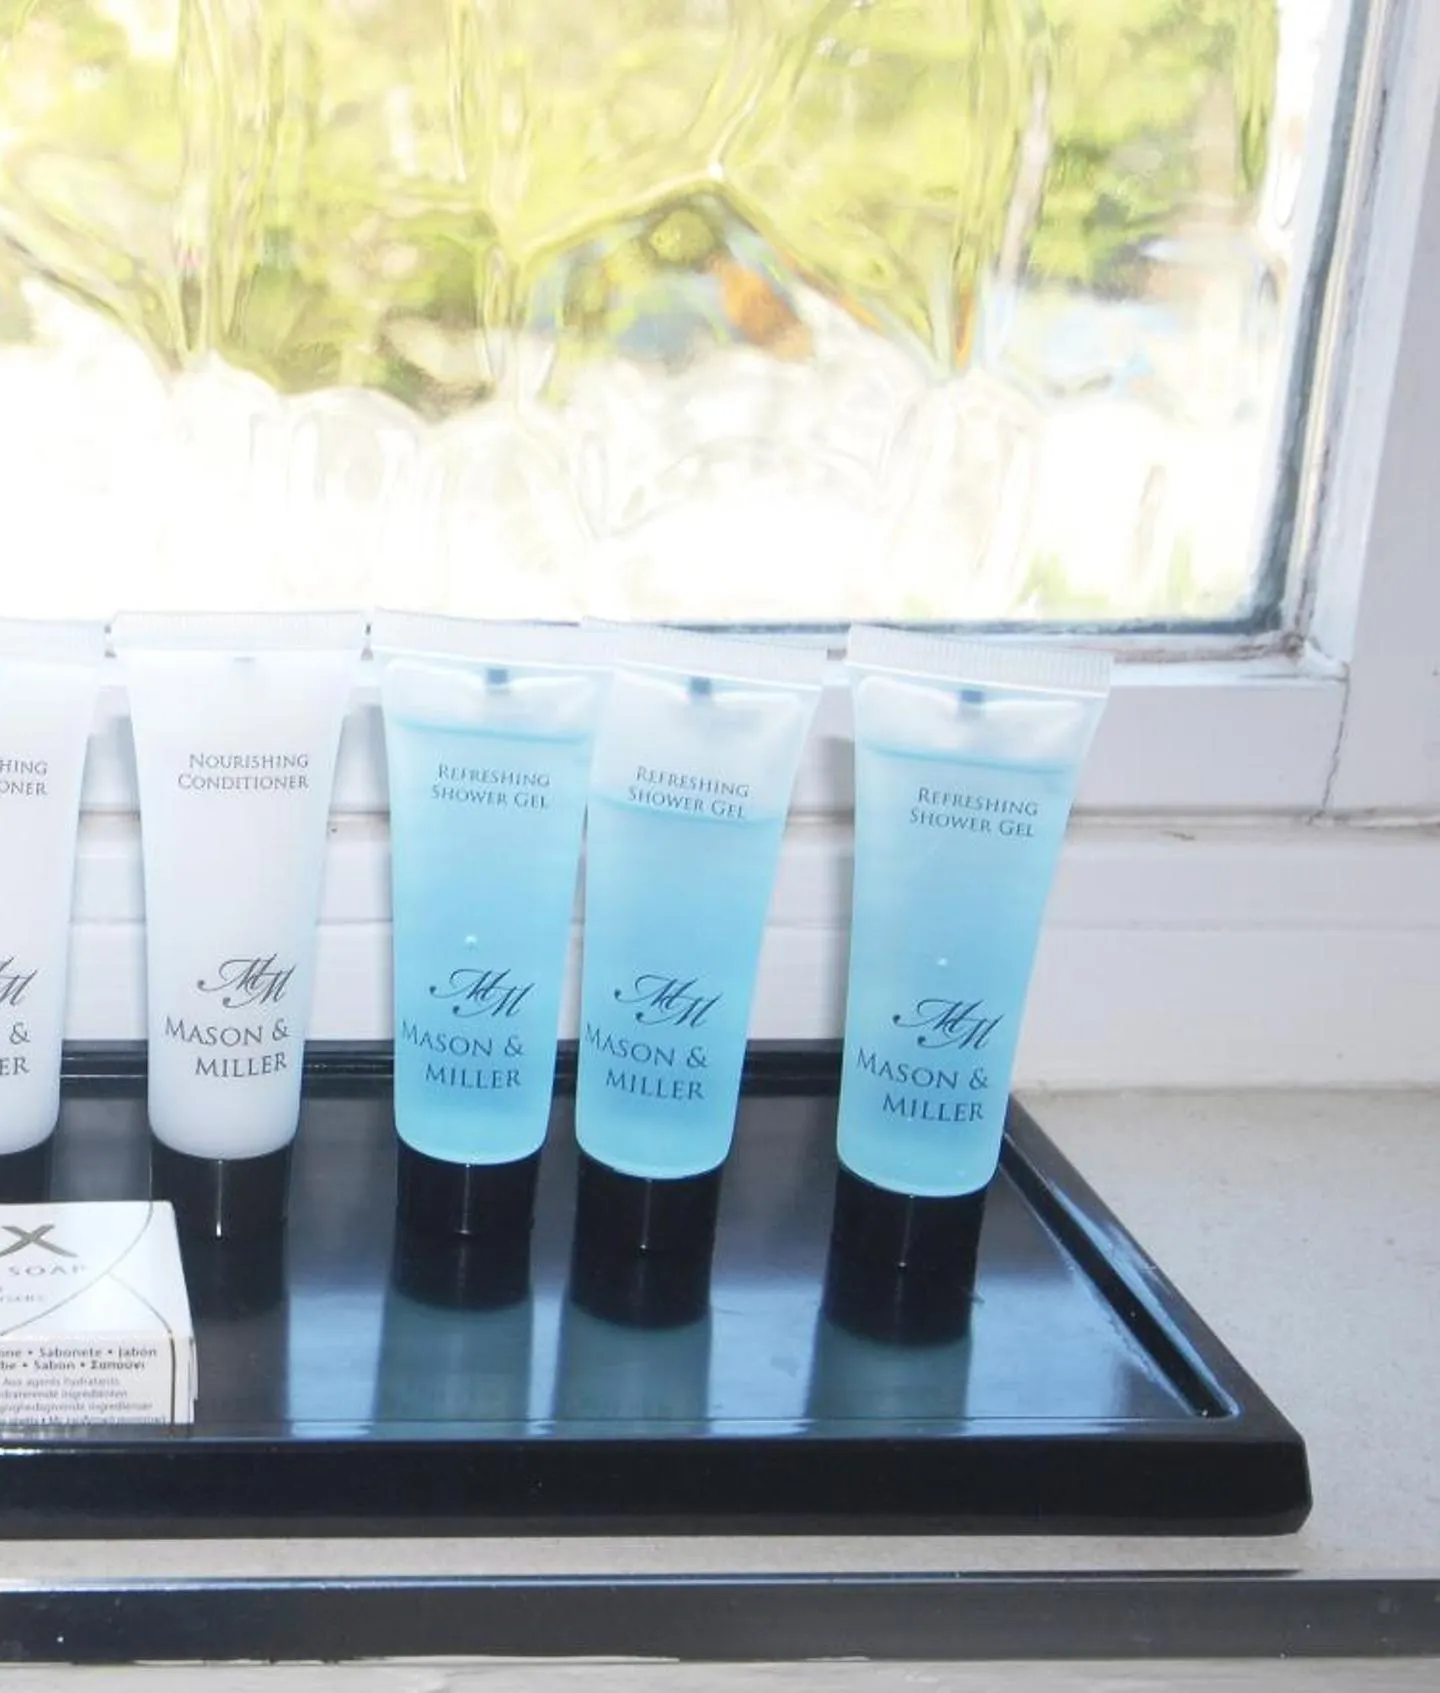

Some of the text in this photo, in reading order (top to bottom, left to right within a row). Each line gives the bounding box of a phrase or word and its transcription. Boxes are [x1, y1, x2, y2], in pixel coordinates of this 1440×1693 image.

[188, 752, 309, 770] NOURISHING
[438, 762, 551, 790] REFRESHING
[177, 773, 310, 791] CONDITIONER
[431, 784, 546, 809] SHOWER GEL
[636, 765, 750, 798] REFRESHING
[629, 787, 743, 819] SHOWER GEL
[917, 786, 1038, 817] REFRESHING
[909, 806, 1034, 838] SHOWER GEL
[8, 1021, 31, 1046] &
[165, 1015, 291, 1048] MASON &
[402, 1019, 525, 1058] MASON &
[584, 1022, 709, 1070] MASON &
[195, 1051, 287, 1078] MILLER
[425, 1062, 521, 1090] MILLER
[856, 1052, 989, 1092] MASON &
[605, 1067, 704, 1101] MILLER
[882, 1092, 984, 1123] MILLER
[40, 1347, 102, 1358] Sabonete
